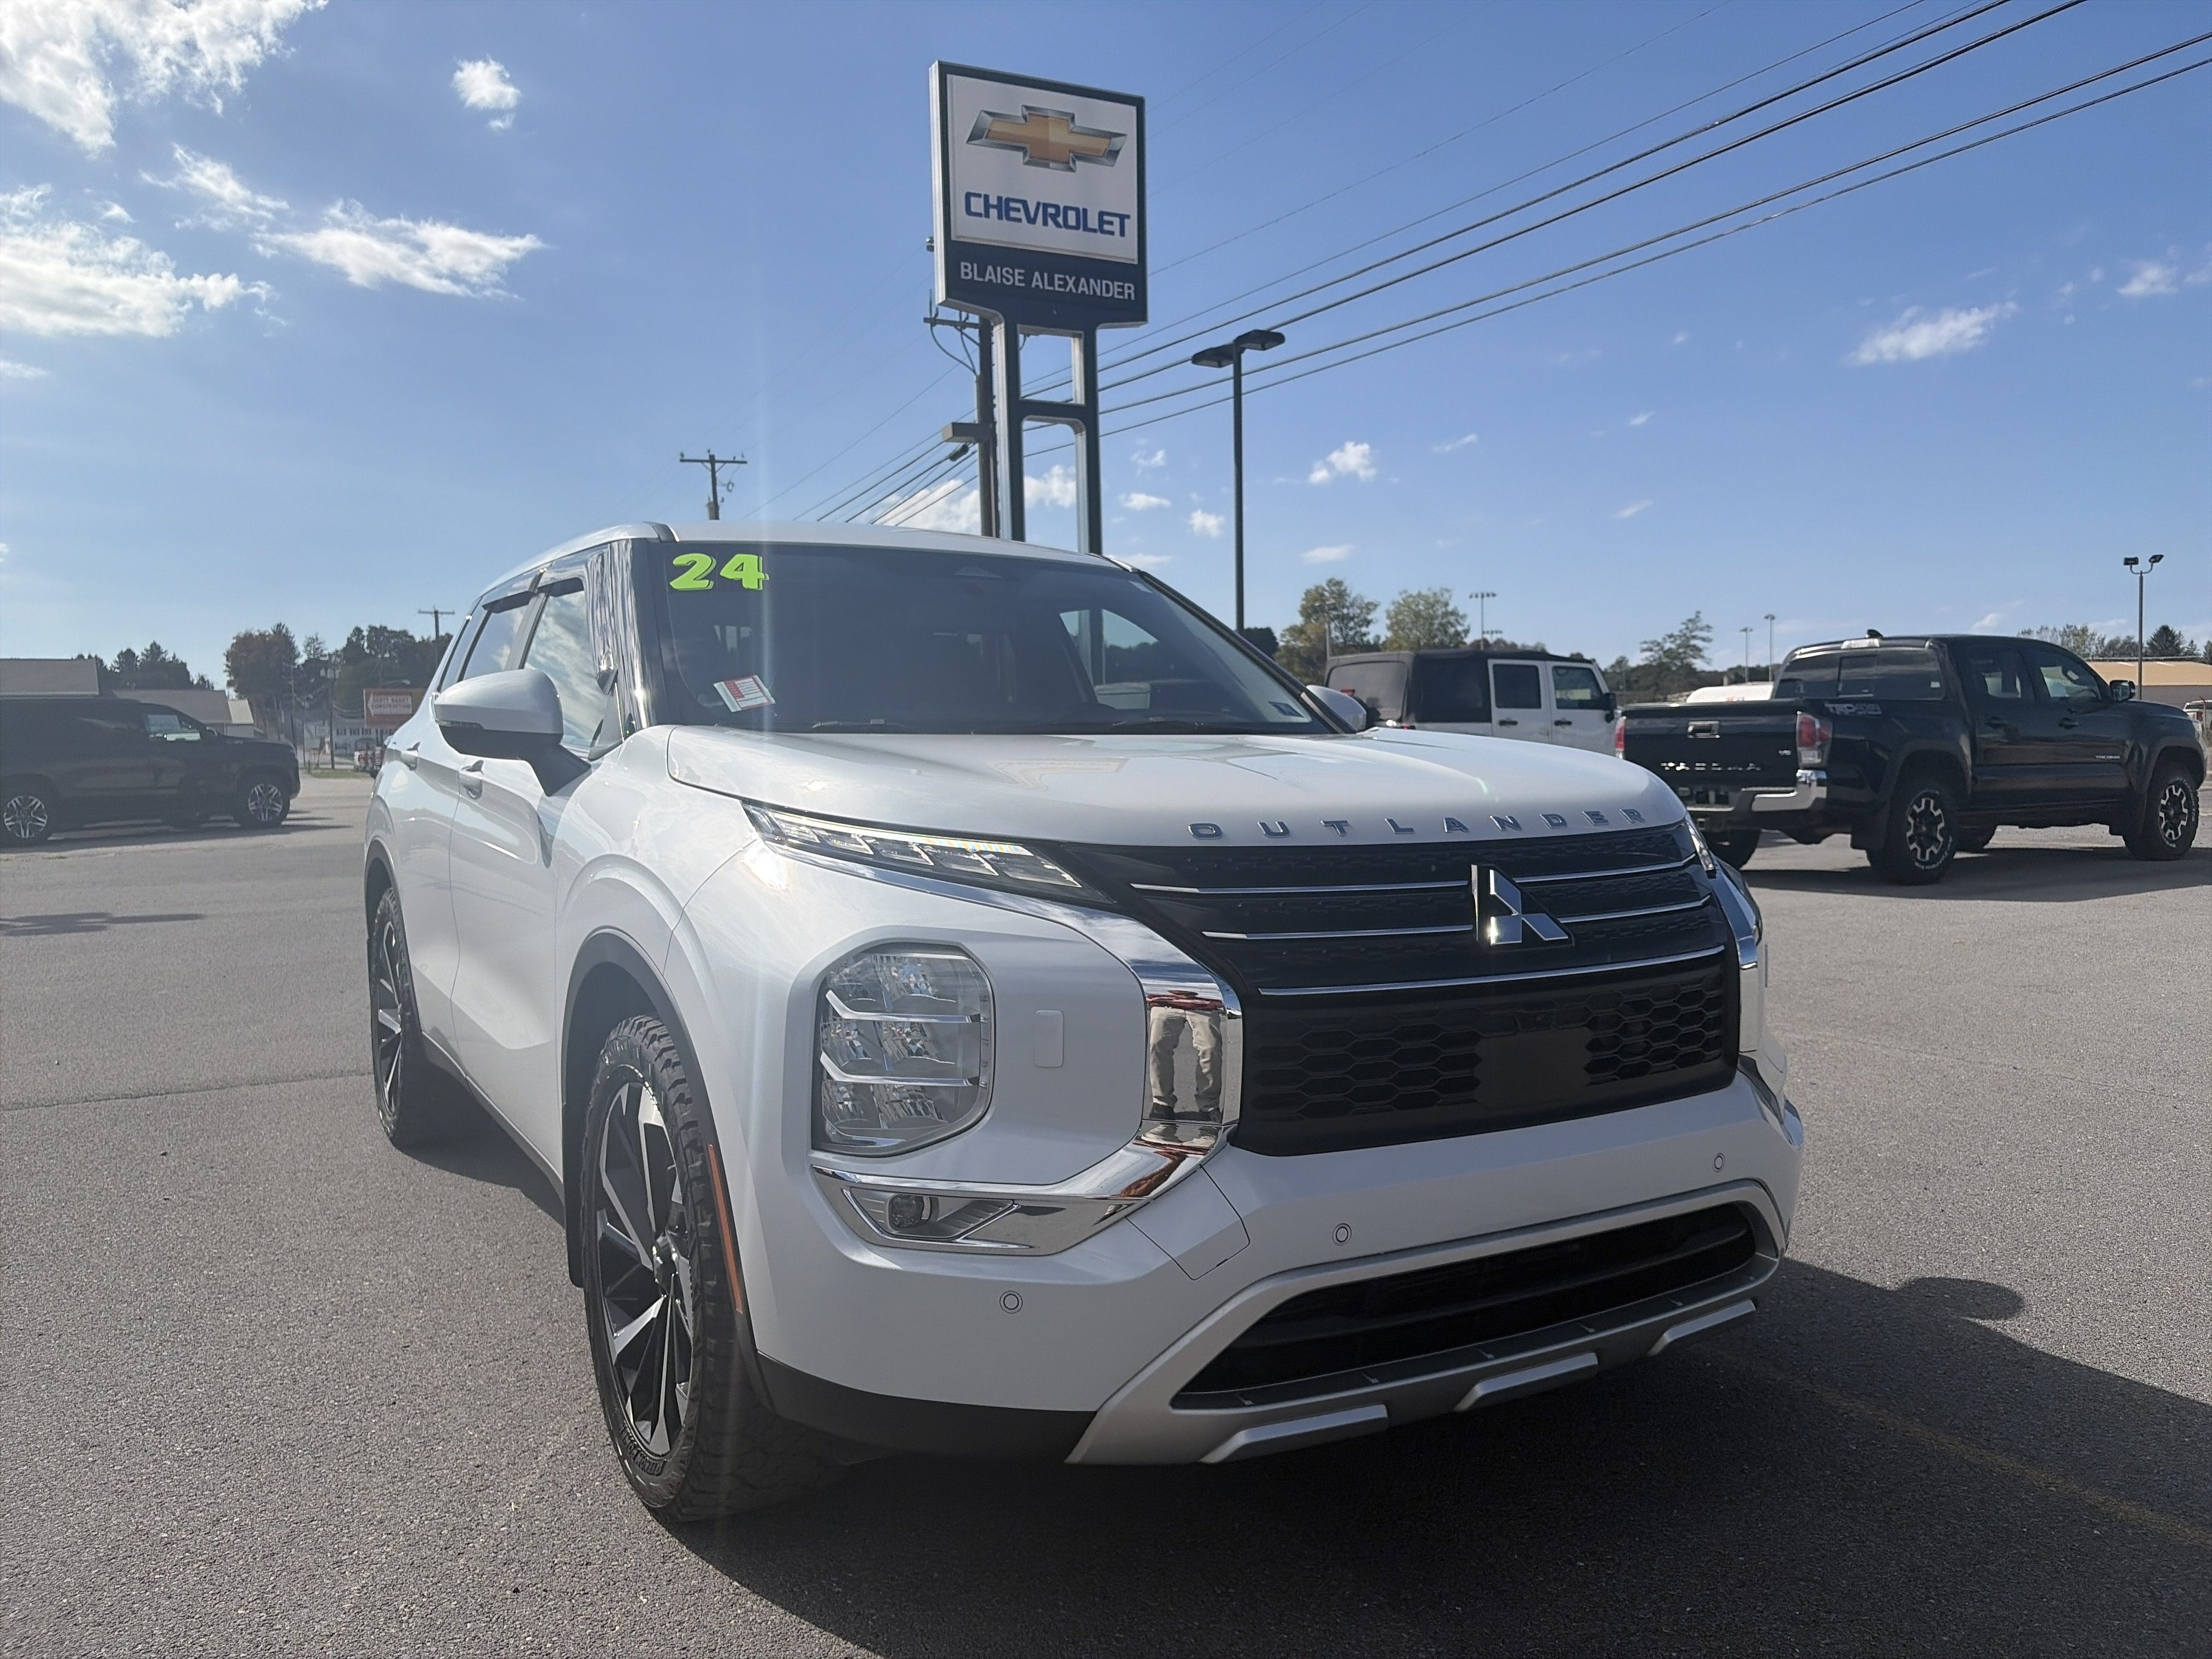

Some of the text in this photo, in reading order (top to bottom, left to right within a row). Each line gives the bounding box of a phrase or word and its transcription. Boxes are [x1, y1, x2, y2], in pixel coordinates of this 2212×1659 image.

[964, 191, 1131, 237] CHEVROLET
[960, 262, 1135, 300] BLAISE ALEXANDER
[669, 553, 769, 590] 24
[1187, 808, 1646, 839] OUTLANDER
